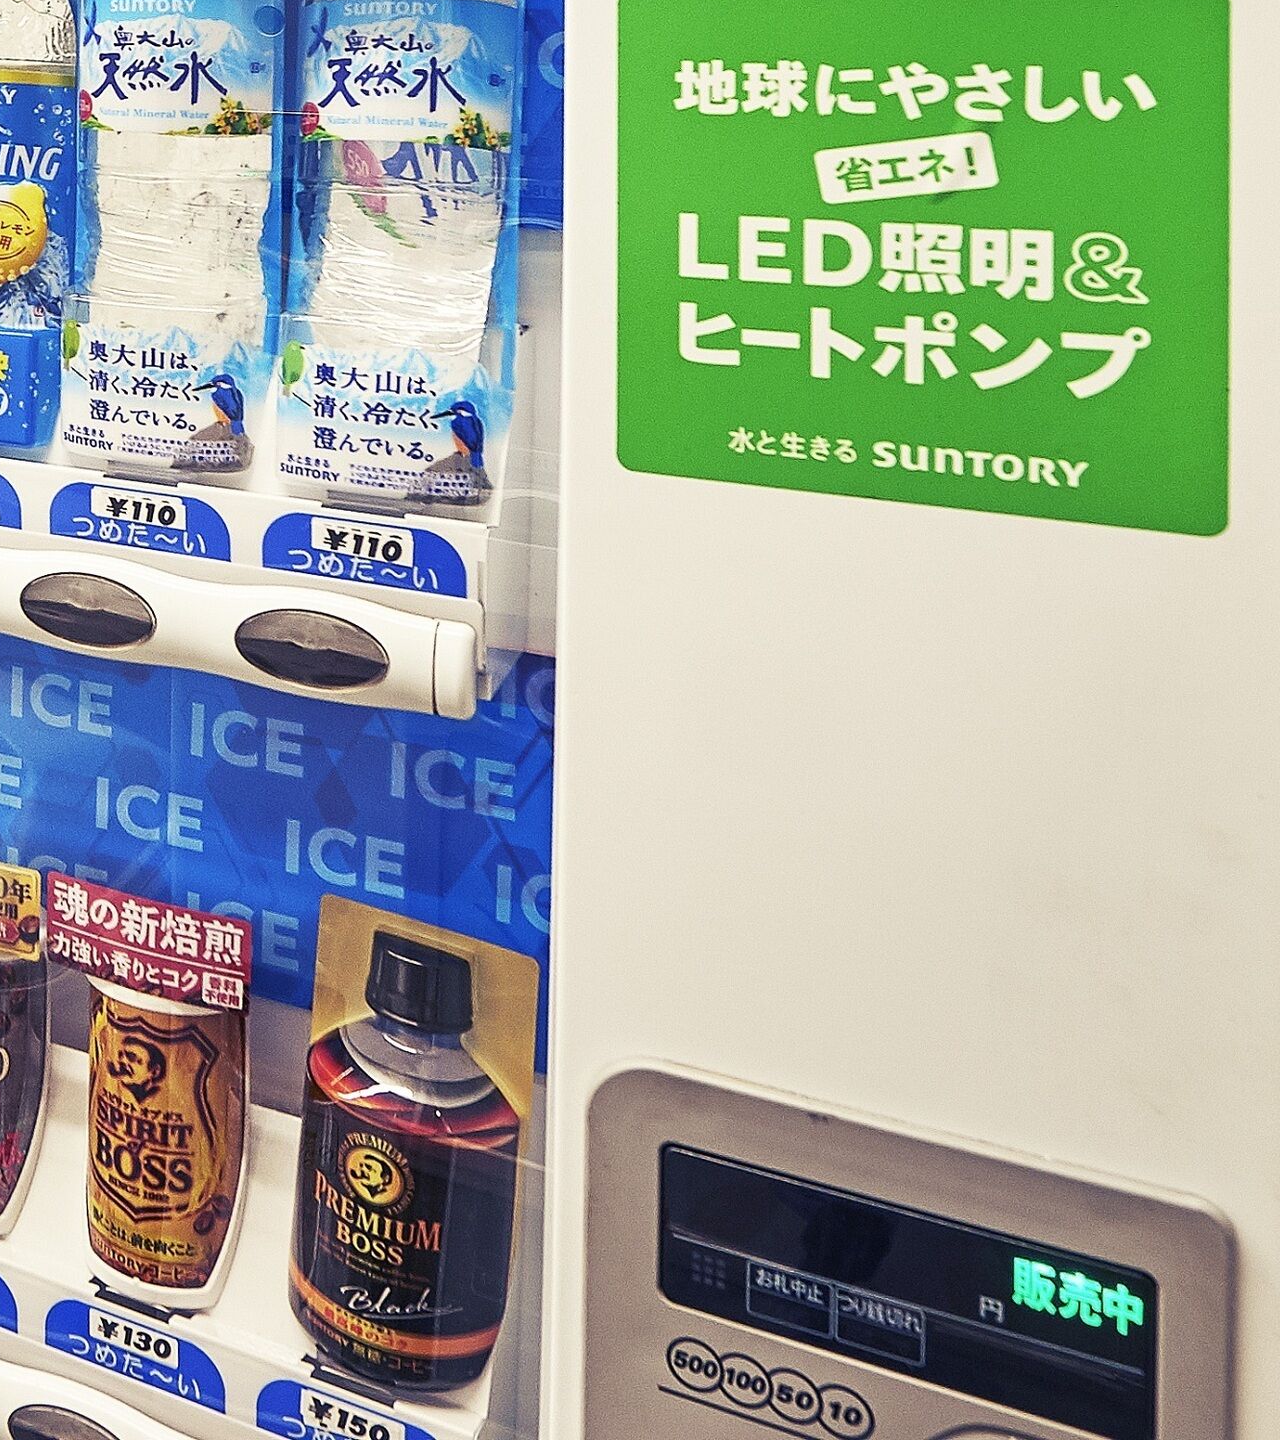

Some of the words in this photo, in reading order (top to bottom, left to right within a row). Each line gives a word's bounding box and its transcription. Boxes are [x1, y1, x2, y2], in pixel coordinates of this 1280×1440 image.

[343, 0, 438, 16] SUNTORY
[114, 30, 195, 50] 奥大山の
[347, 30, 436, 52] 奥大山の
[91, 52, 227, 100] 天然水
[321, 56, 467, 111] 天然水
[673, 58, 1158, 124] 地球にやさしい
[88, 341, 199, 372] 奥大山は、
[678, 302, 1152, 400] ヒートポンプ
[88, 370, 200, 402] 清く、冷たく、
[314, 364, 437, 397] 奥大山は、
[69, 423, 105, 438] 水と生きる
[89, 398, 197, 432] 澄んでいる。
[314, 394, 440, 430] 清く、冷たく、
[64, 431, 114, 451] SUNTORY
[287, 454, 330, 468] 水と生きる
[313, 426, 434, 463] 澄んでいる。
[729, 426, 858, 464] 水と生きる
[872, 440, 1089, 488] SUNTORY
[280, 463, 339, 482] SUNTORY
[106, 497, 175, 525] ¥110
[11, 667, 113, 737] ICE
[96, 777, 204, 852] ICE
[53, 880, 244, 965] 魂の新焙煎
[52, 931, 199, 992] 力強い香りとコク
[97, 1100, 194, 1147] SPIRIT
[95, 1131, 192, 1195] BOSS
[315, 1168, 442, 1253] PREMIUM
[336, 1220, 403, 1266] BOSS
[1012, 1256, 1145, 1337] 販売中
[674, 1349, 719, 1381] 500
[724, 1366, 766, 1399] 100
[775, 1383, 813, 1412] 50
[829, 1399, 863, 1426] 10
[308, 1397, 391, 1440] ¥150
